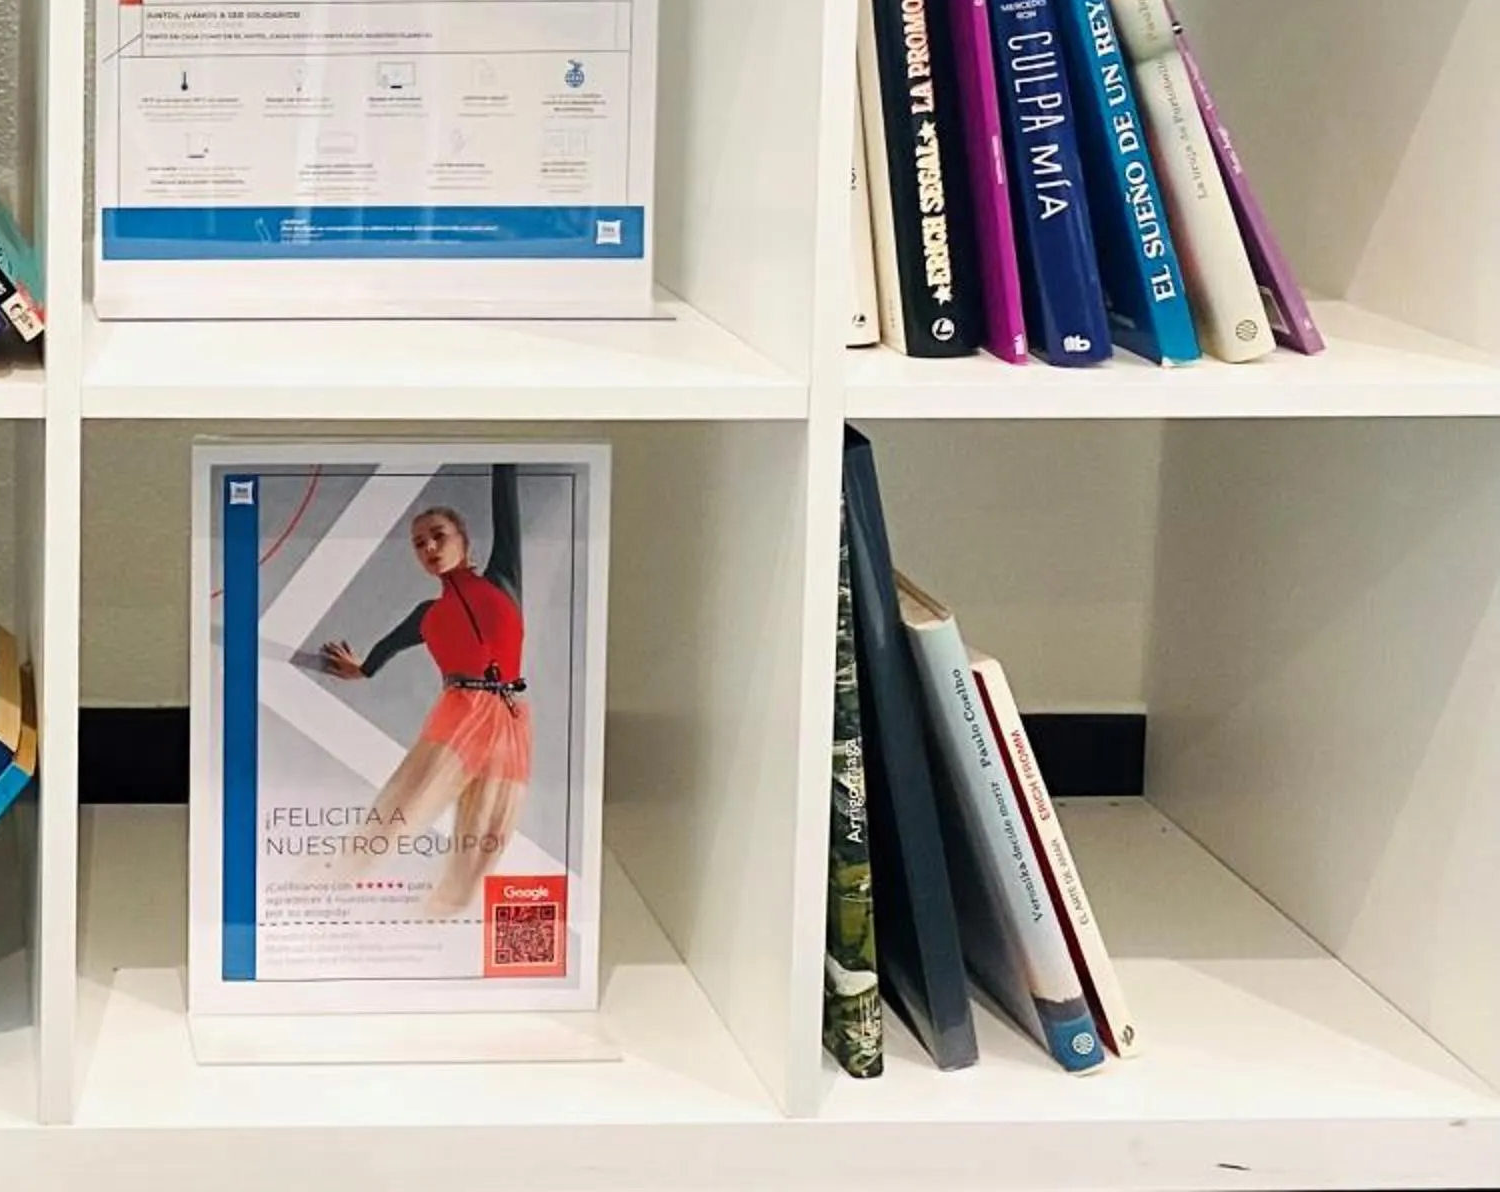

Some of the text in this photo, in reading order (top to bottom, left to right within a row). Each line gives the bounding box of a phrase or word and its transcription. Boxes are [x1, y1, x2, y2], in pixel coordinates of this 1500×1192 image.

[910, 78, 935, 115] LA
[1008, 31, 1071, 220] CULPA MÍA
[1085, 0, 1177, 303] EL SUEÑO DE UN REY
[914, 139, 946, 214] SEGAL
[922, 213, 952, 287] ERICH
[953, 668, 977, 723] Coelho
[971, 722, 992, 769] Paulo
[846, 737, 865, 843] Arrigorriaga
[266, 807, 407, 830] ¡FELICITA A
[266, 834, 506, 858] NUESTRO EQUIPO!
[1005, 819, 1023, 861] decide
[1011, 728, 1085, 912] ARTE ERICH FROMM
[408, 882, 433, 894] para
[503, 885, 549, 901] Google
[1018, 861, 1044, 923] Veronika
